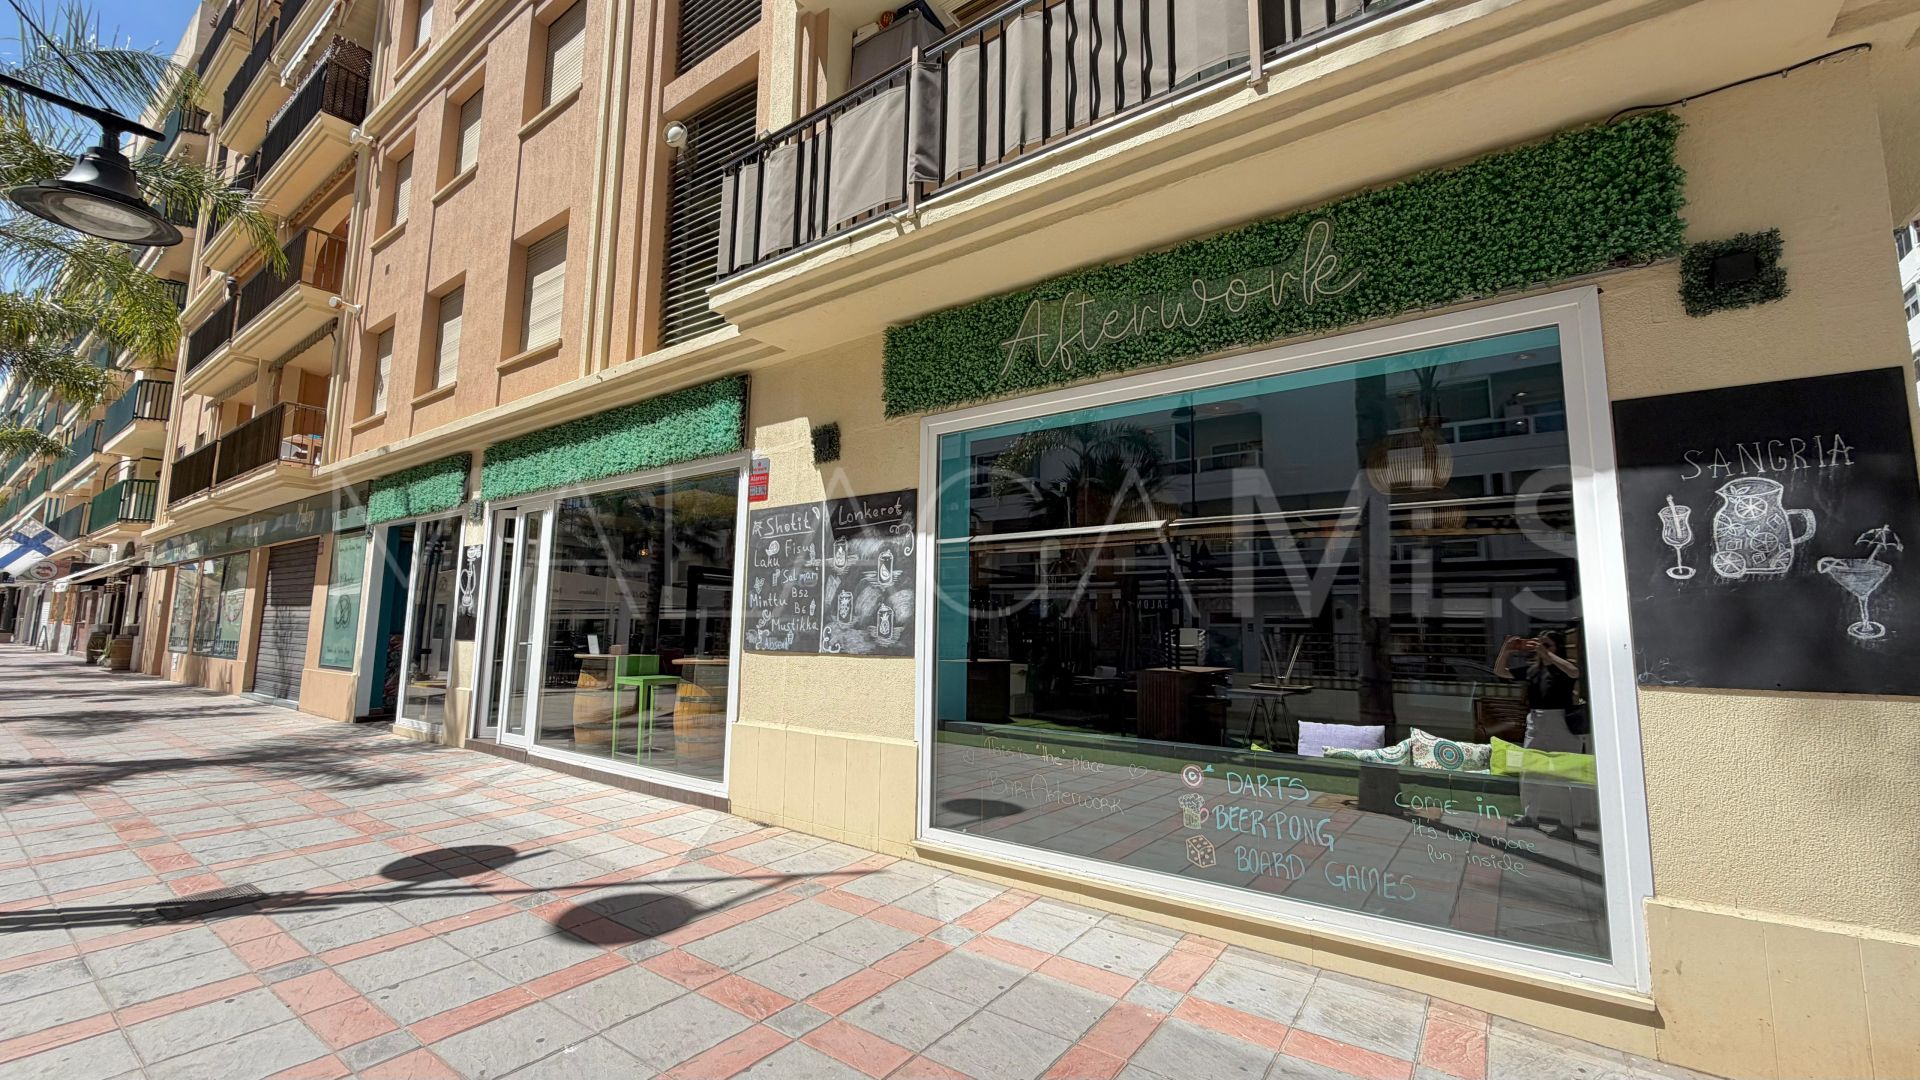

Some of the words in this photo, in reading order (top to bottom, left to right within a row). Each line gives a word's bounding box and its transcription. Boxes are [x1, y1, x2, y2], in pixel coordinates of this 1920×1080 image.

[1001, 220, 1363, 376] Afterwork
[1681, 433, 1855, 481] SANGRIA
[838, 497, 903, 526] Lonkerot
[764, 513, 812, 537] Shotit
[754, 549, 780, 568] Laku
[785, 538, 811, 557] Fisu
[750, 592, 788, 608] Minttu
[791, 586, 809, 598] B52
[771, 616, 819, 632] Mustikka
[1072, 755, 1105, 773] place
[1226, 771, 1310, 801] DARTS
[1476, 796, 1501, 820] in
[1212, 804, 1267, 838] BEER
[1267, 810, 1335, 852] PONG
[1234, 845, 1306, 881] BOARD
[1324, 860, 1417, 901] GAMES
[1465, 850, 1529, 878] inside
